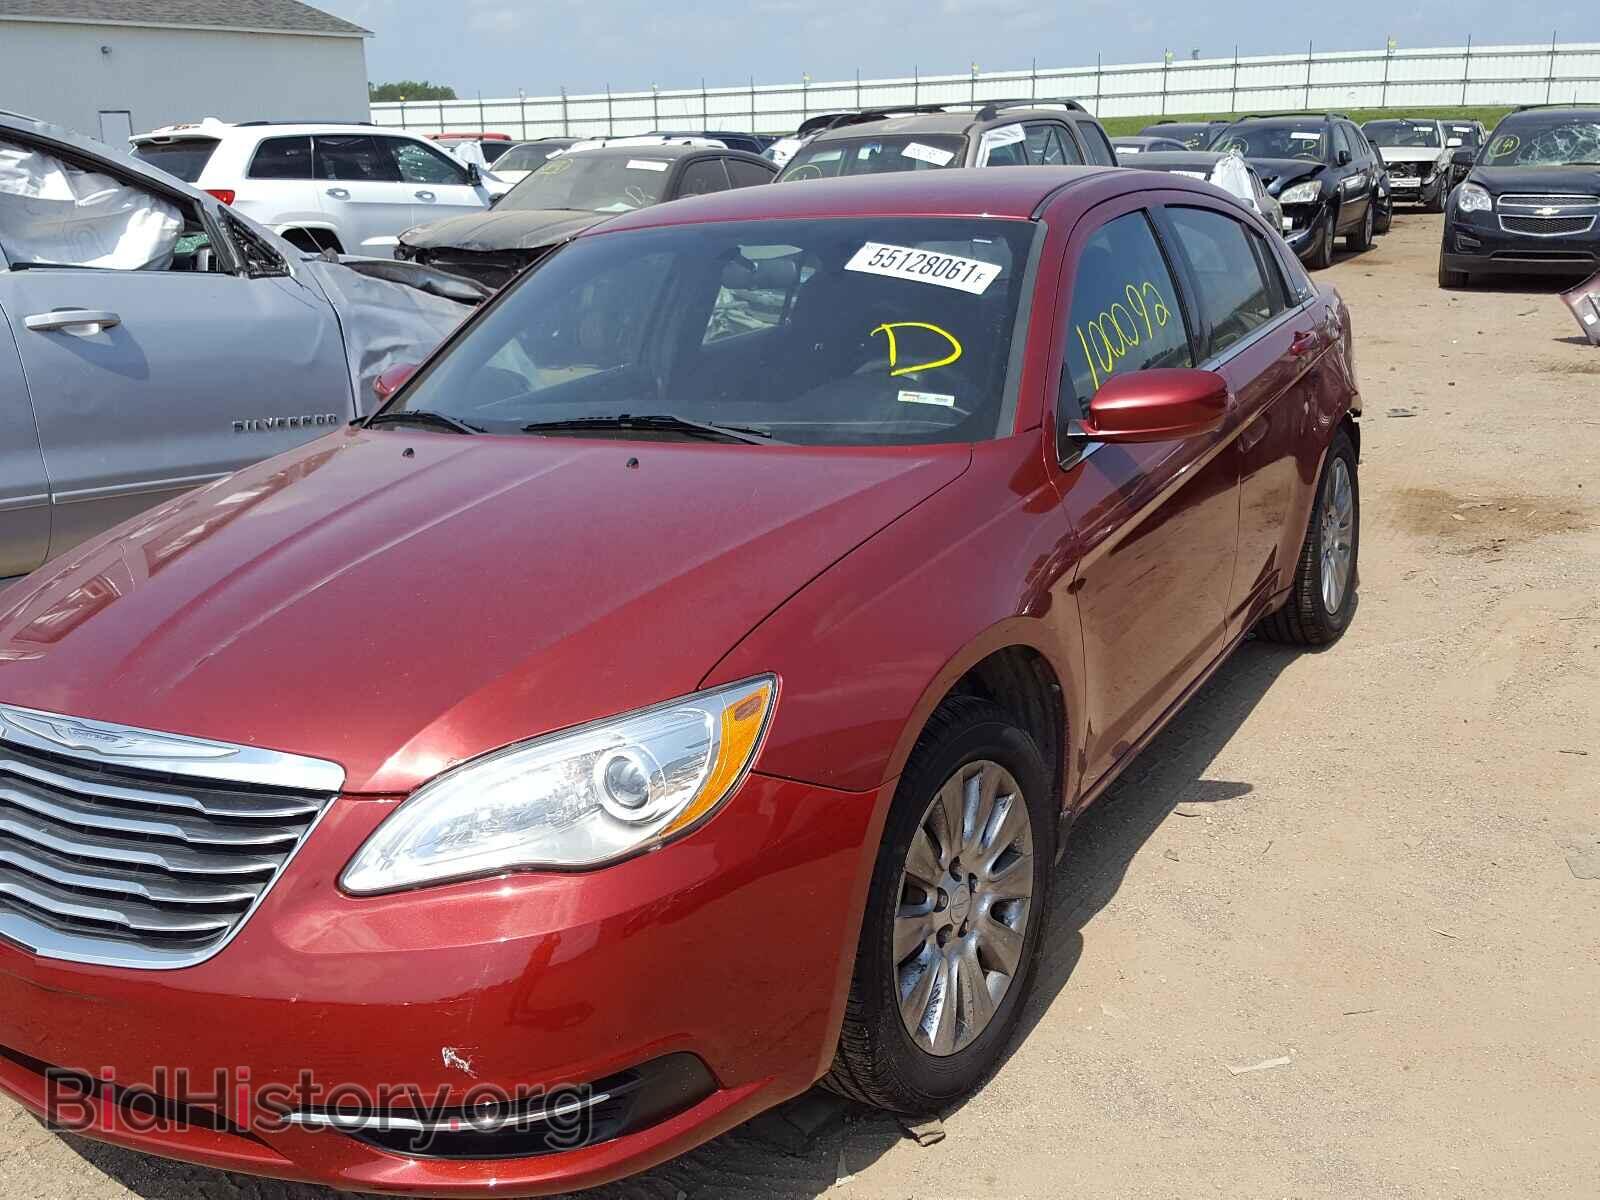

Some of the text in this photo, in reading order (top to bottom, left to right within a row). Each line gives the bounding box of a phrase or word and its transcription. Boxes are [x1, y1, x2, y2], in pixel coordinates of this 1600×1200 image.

[868, 247, 978, 283] 55128061
[870, 321, 963, 377] D
[1075, 281, 1172, 391] 100092
[232, 413, 337, 432] SILVERADO
